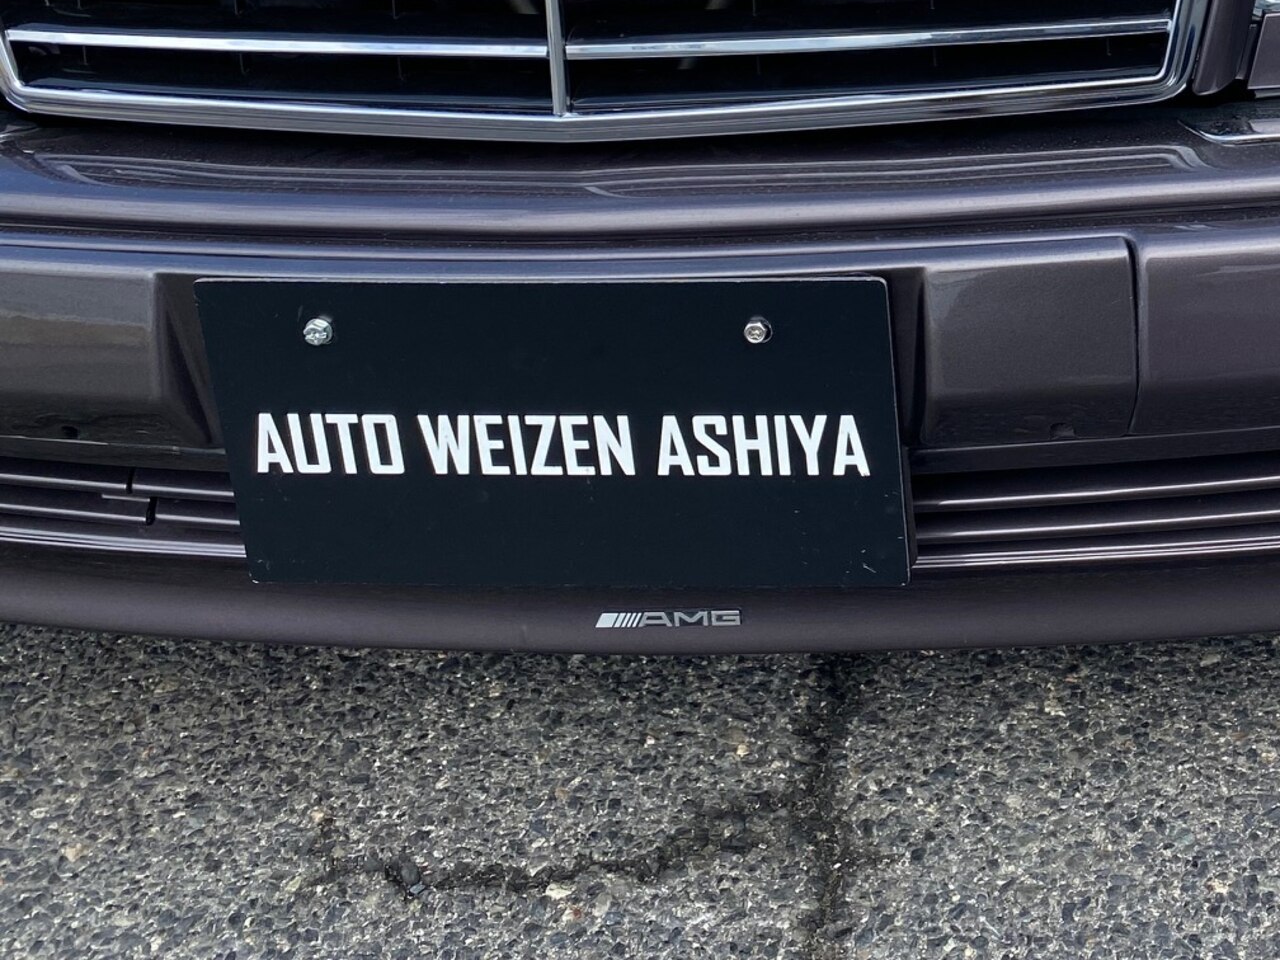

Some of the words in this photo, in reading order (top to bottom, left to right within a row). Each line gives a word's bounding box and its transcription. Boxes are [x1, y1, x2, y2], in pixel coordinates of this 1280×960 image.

[256, 412, 406, 476] AUTO
[416, 413, 637, 477] WEIZEN
[656, 414, 871, 478] ASHIYA
[638, 610, 742, 628] AMG
